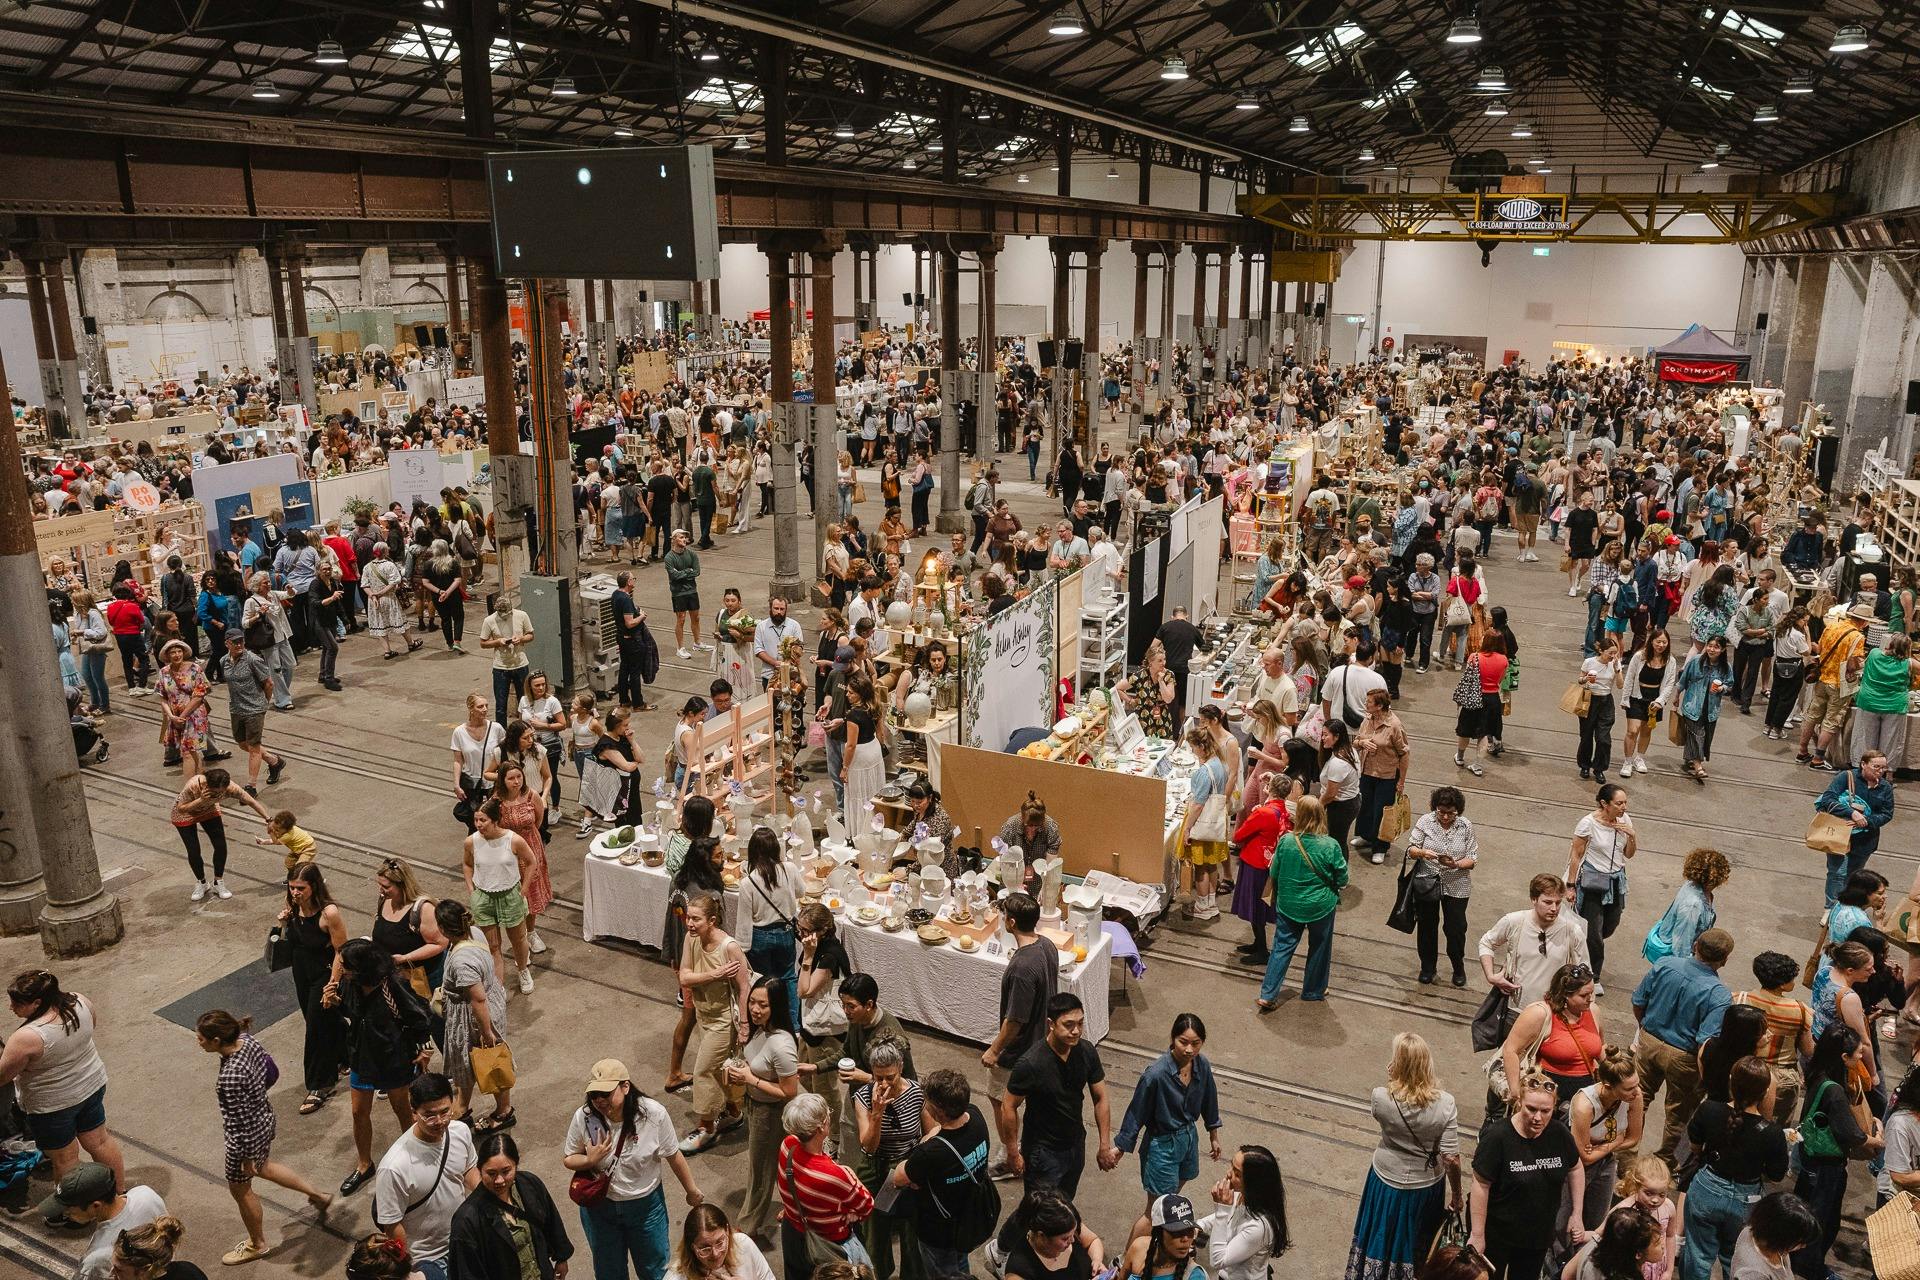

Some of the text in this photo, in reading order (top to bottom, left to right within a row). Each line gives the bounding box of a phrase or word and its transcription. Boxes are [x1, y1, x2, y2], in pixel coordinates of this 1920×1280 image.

[1501, 201, 1539, 219] MOORE
[1504, 222, 1514, 230] NOT
[1515, 222, 1523, 230] TO
[1555, 221, 1570, 230] TONS
[65, 525, 86, 537] patch
